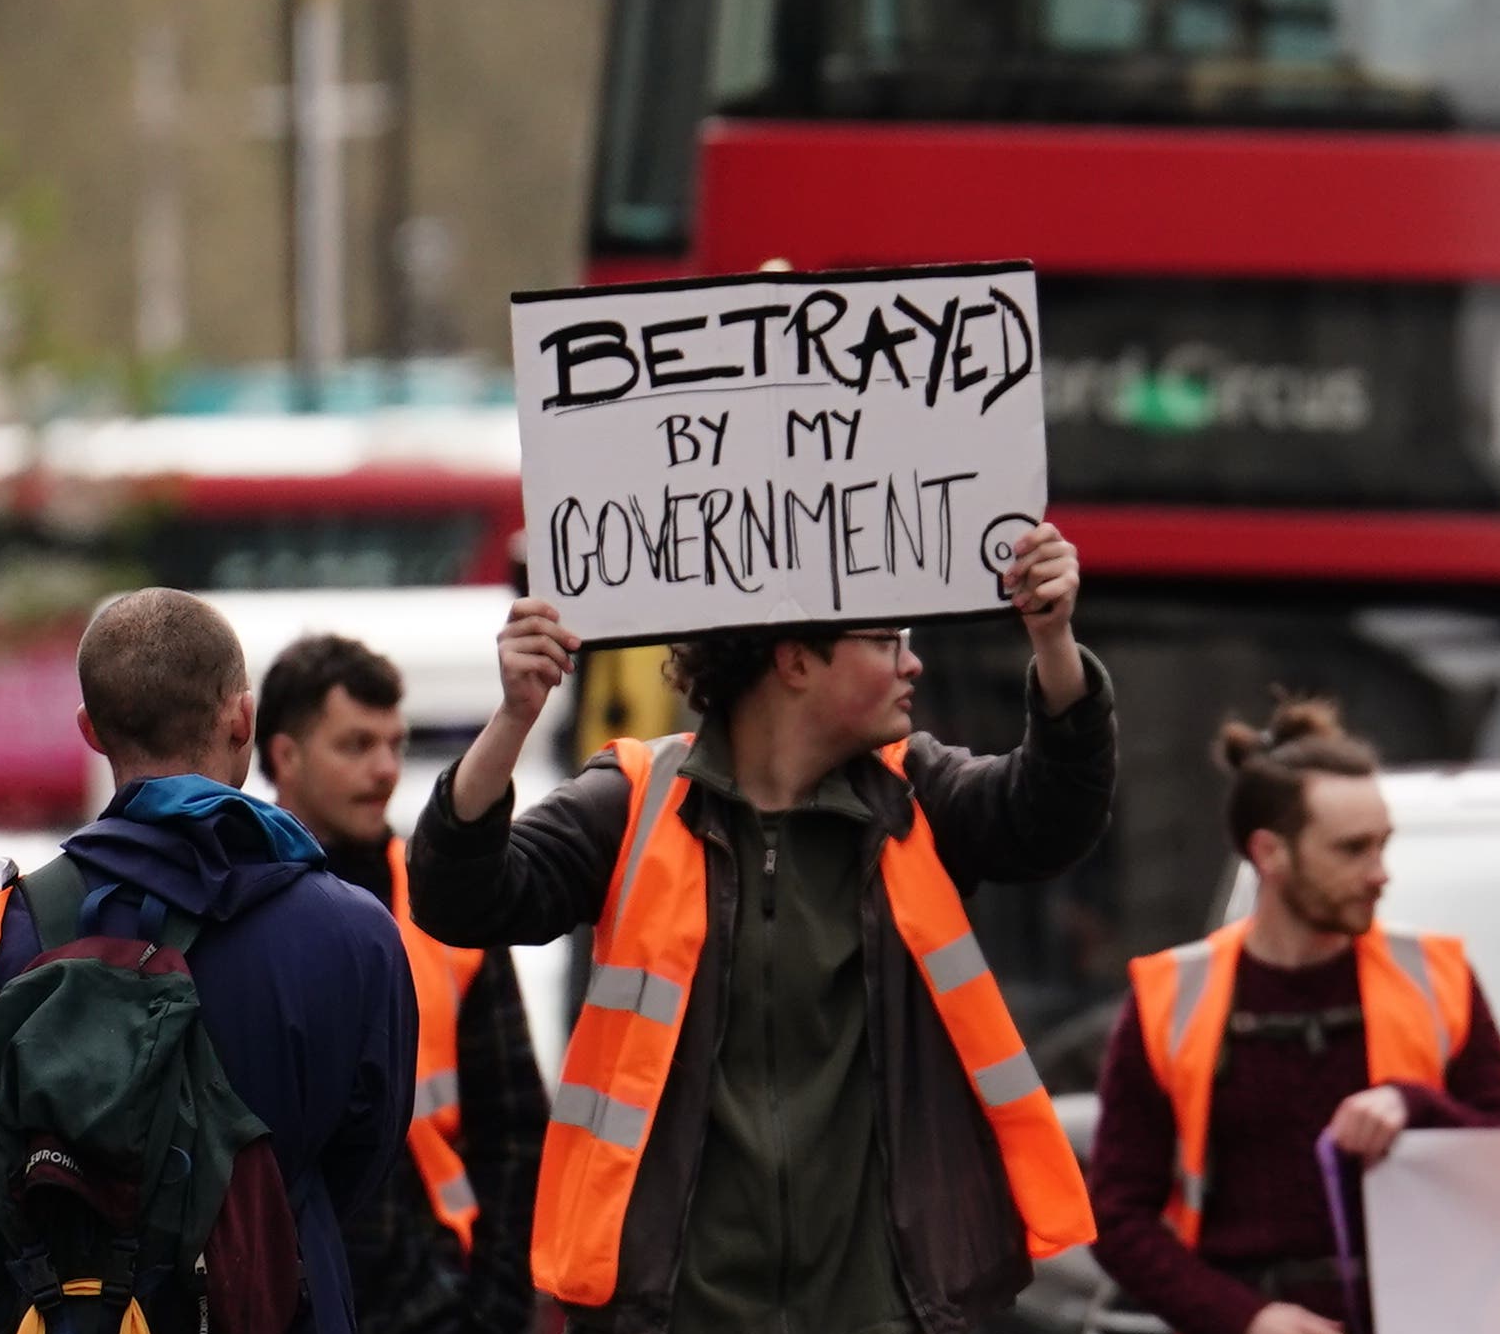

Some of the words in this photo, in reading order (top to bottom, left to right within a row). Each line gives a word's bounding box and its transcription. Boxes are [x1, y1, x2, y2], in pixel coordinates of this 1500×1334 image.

[541, 287, 1034, 415] BETRAYED
[658, 412, 729, 466] BY
[786, 409, 862, 461] MY
[550, 470, 978, 611] GOVERNMENT
